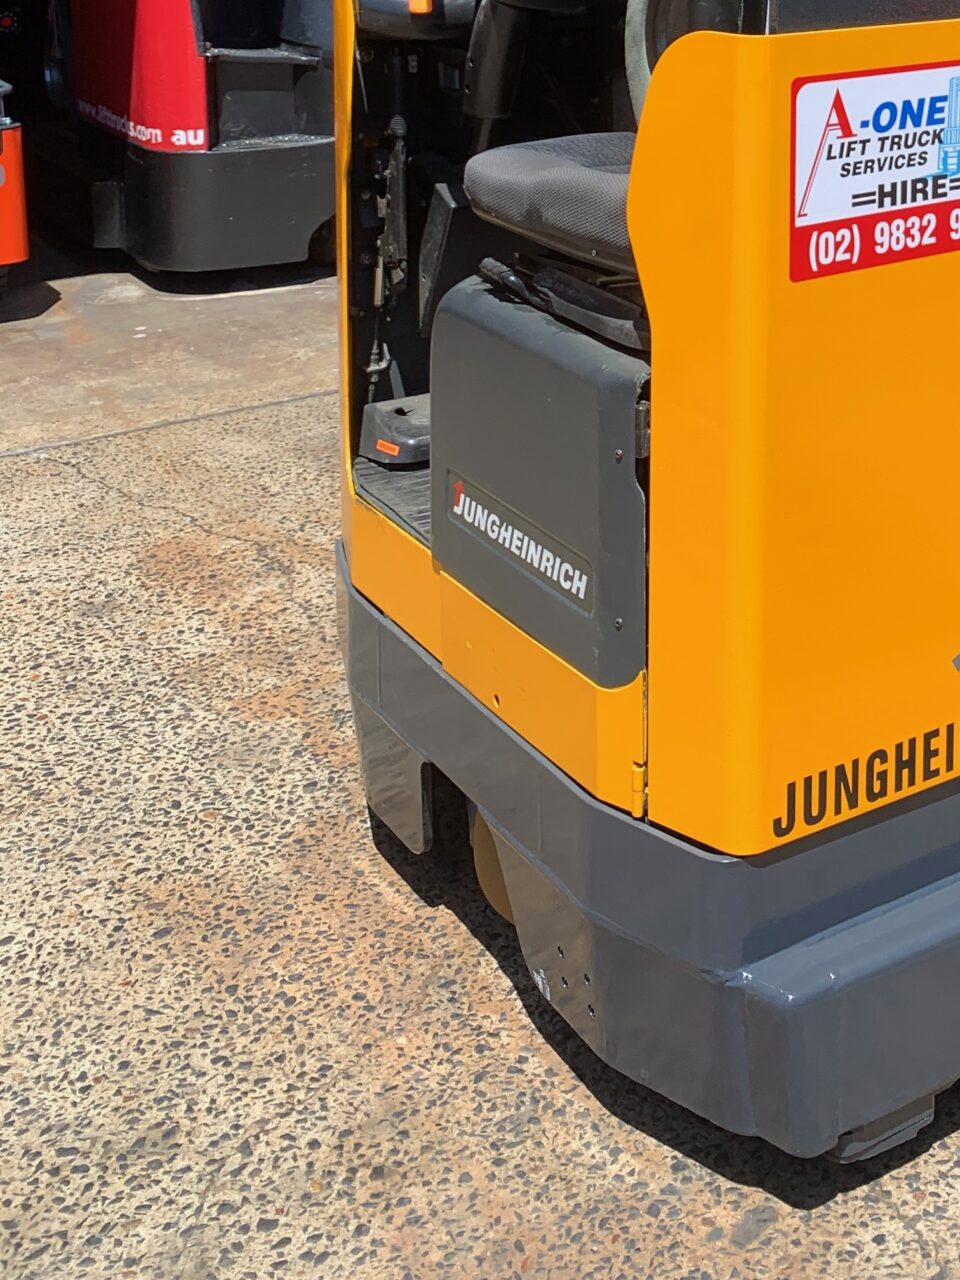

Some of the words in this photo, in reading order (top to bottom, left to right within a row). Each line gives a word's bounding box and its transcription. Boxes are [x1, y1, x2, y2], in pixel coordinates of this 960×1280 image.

[171, 128, 205, 146] au
[826, 138, 871, 161] LIFT
[877, 128, 946, 153] TRUCK
[839, 151, 929, 178] SERVICES
[808, 223, 860, 272] (02)
[874, 212, 937, 255] 9832
[453, 492, 588, 600] JUNGHEINRICH
